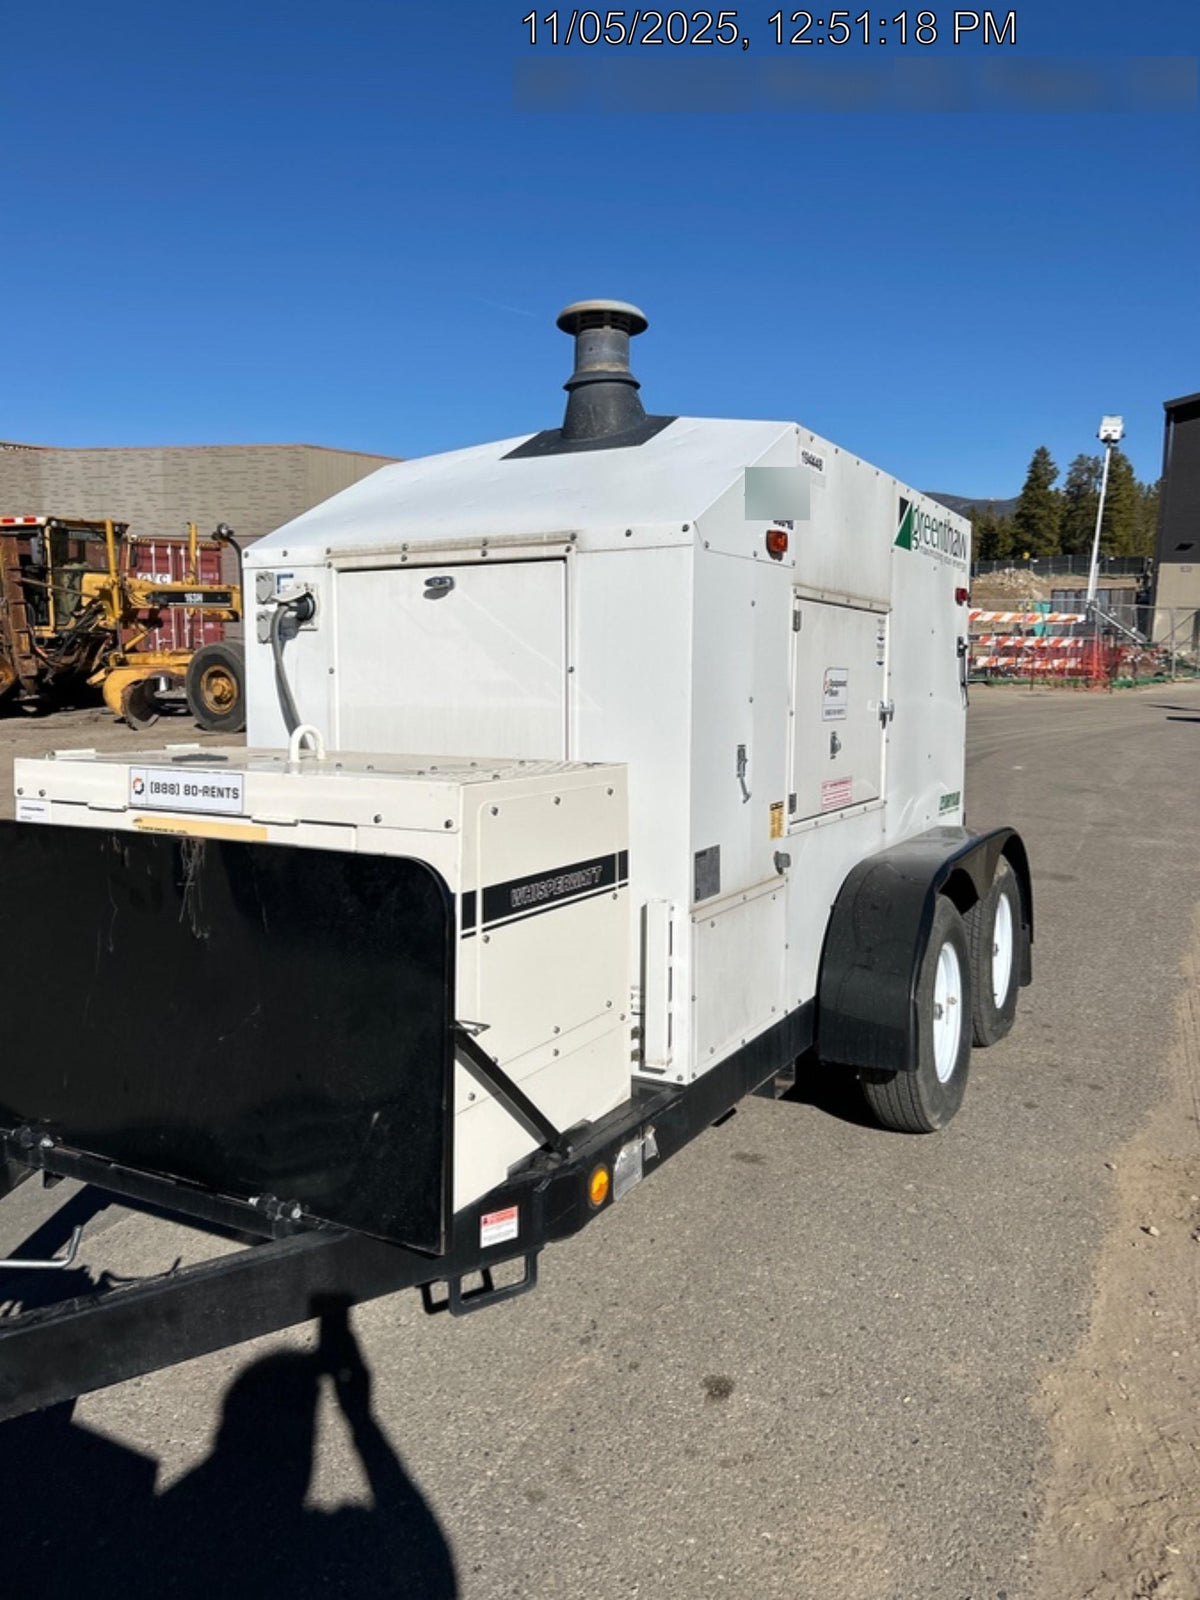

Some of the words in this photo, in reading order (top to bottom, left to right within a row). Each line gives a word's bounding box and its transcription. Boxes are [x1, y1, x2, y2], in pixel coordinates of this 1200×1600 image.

[911, 504, 967, 560] greenthaw
[183, 784, 240, 799] 80-RENTS
[510, 865, 603, 908] WHISPERWATT
